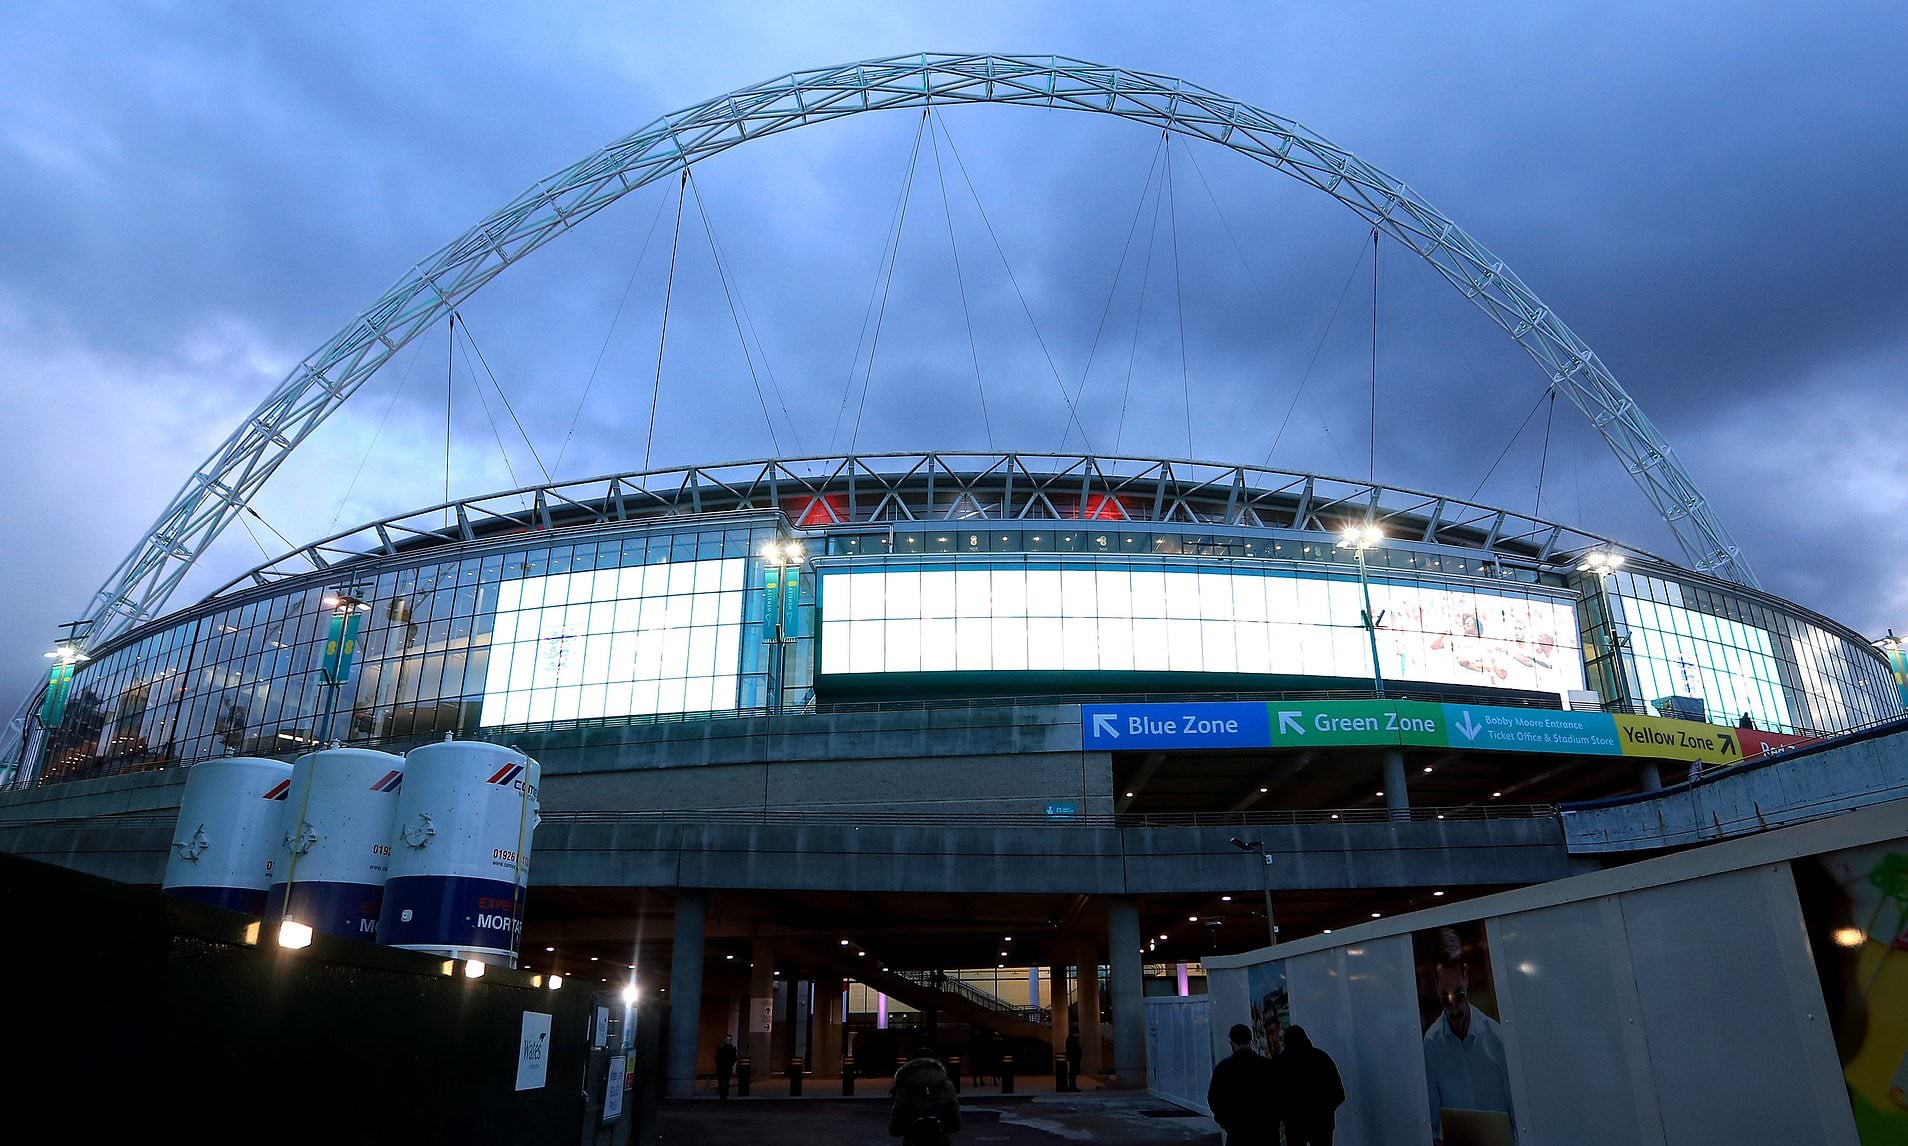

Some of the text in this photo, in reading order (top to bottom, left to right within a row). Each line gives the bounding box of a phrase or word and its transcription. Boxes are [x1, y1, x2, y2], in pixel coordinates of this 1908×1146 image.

[1128, 715, 1239, 736] Blue Zone
[1314, 712, 1436, 732] Green Zone
[1485, 715, 1584, 730] Bobby Moore Entrance
[1488, 730, 1615, 746] Ticket Office & Stadium Store
[1622, 726, 1715, 751] Yellow Zone
[493, 848, 516, 862] 01926
[523, 1040, 542, 1060] Wates
